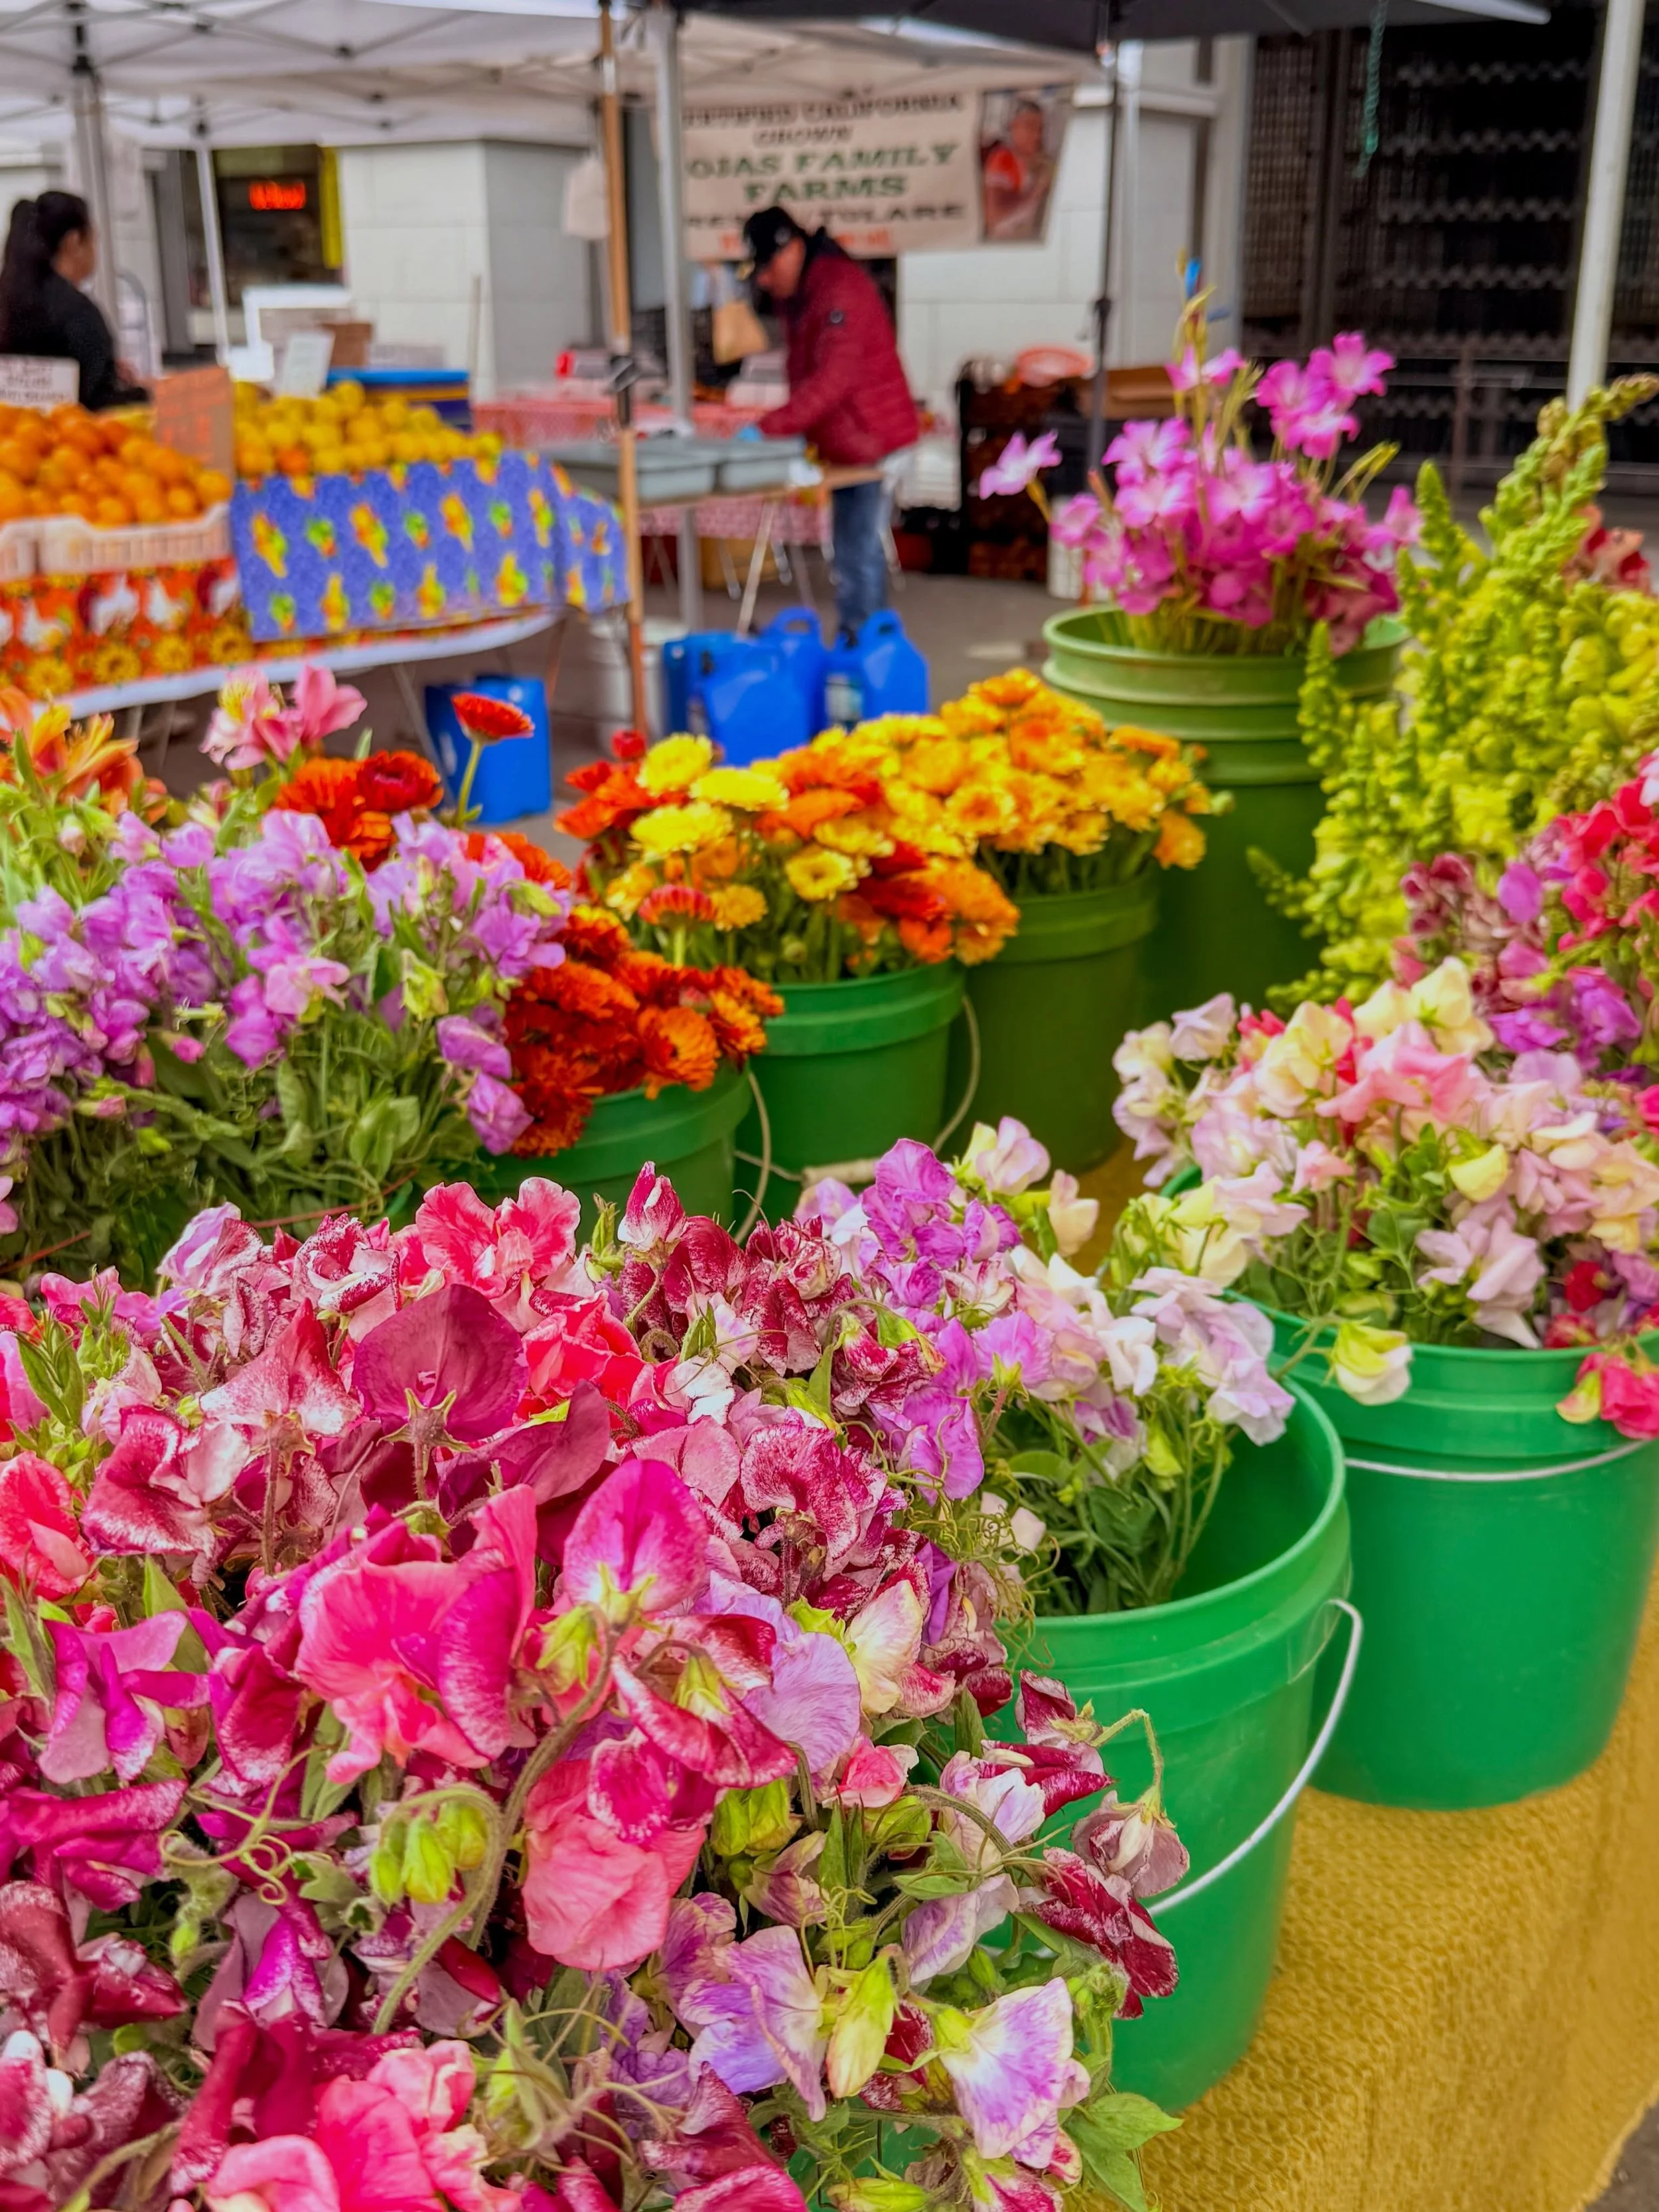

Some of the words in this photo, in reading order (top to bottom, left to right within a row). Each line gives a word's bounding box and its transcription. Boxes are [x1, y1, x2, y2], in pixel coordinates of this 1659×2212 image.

[804, 95, 961, 119] CALIFORNIA
[689, 155, 780, 176] OJAS
[796, 145, 958, 171] FAMILY
[746, 177, 906, 200] FARMS
